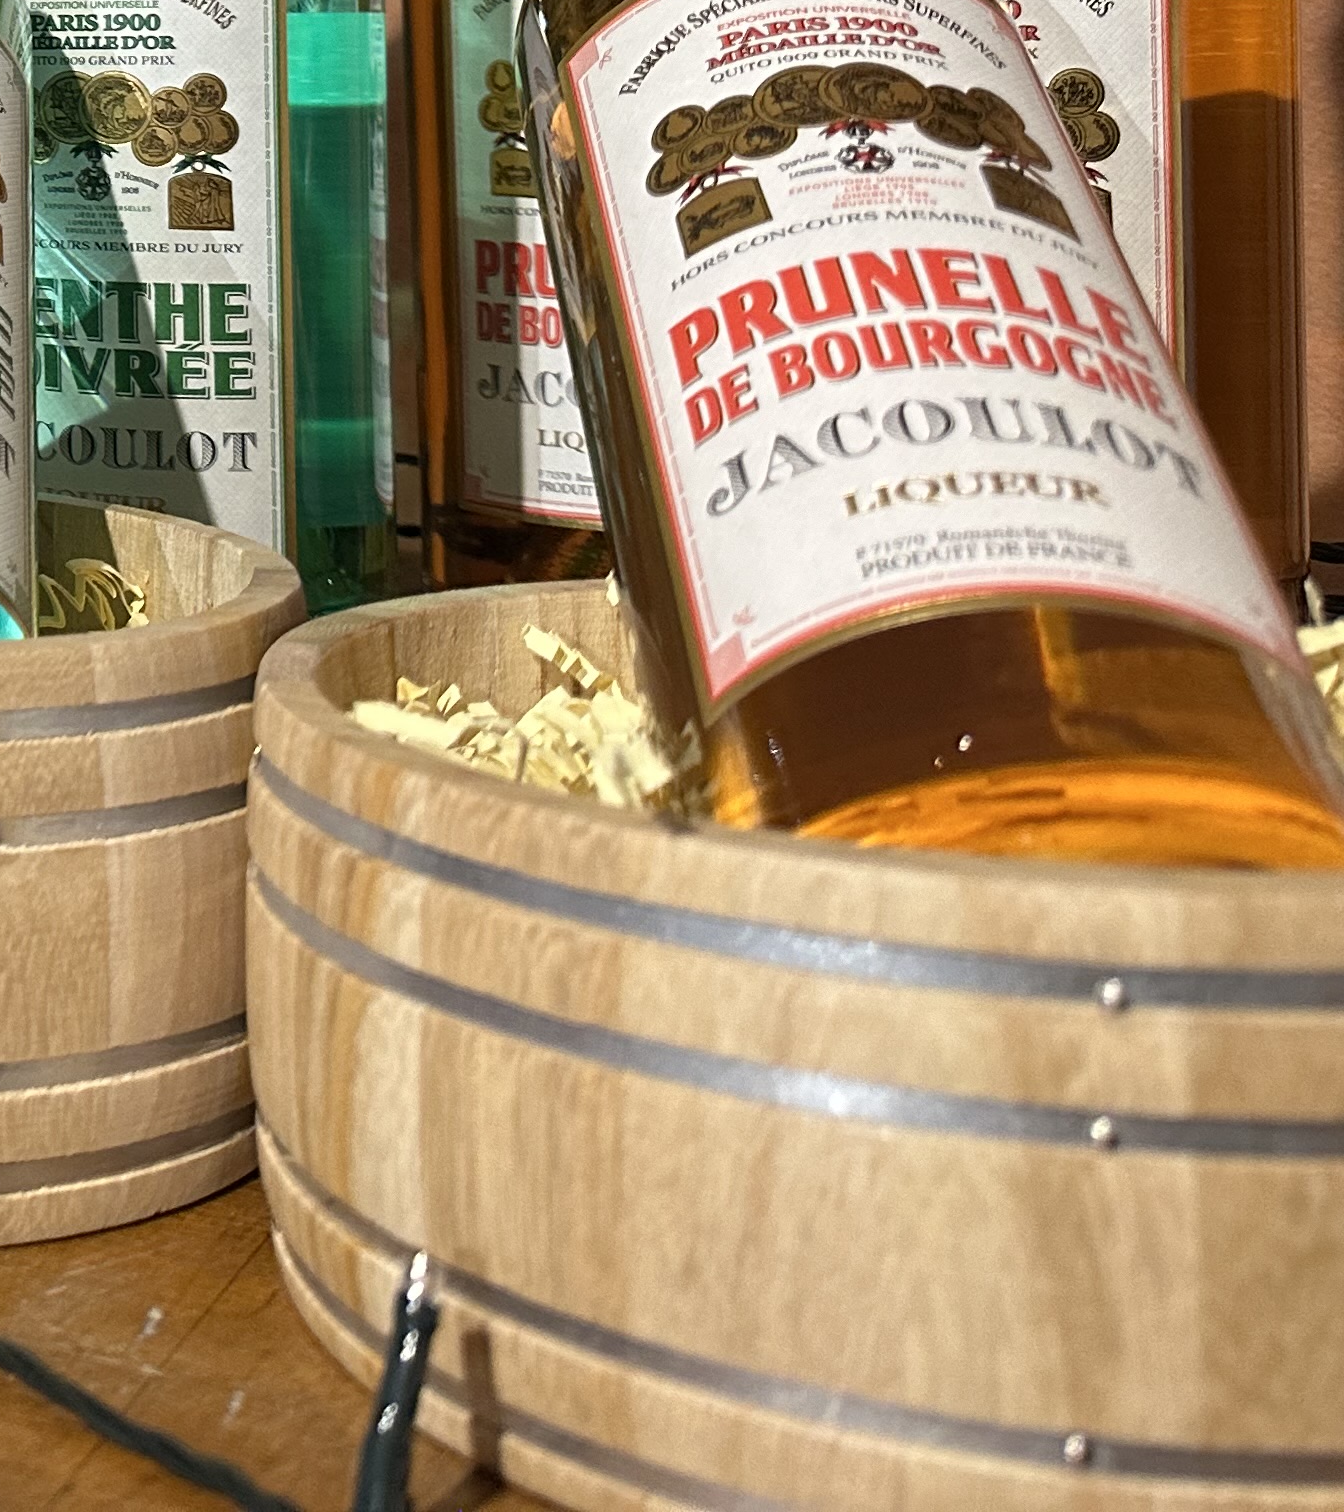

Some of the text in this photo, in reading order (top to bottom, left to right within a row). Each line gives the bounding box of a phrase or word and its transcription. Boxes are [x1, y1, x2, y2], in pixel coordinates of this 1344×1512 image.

[29, 0, 160, 10] EXPOSITION UNIVERSELLE
[31, 13, 162, 32] PARIS 1900
[716, 5, 911, 32] EXPOSITION UNIVERSELLE
[120, 35, 177, 50] D'OR
[704, 33, 947, 73] MÉDAILLE D'OR
[716, 15, 920, 51] PARIS 1900
[62, 54, 177, 66] 1909 GRAND PRIX
[618, 23, 692, 97] FABRIQUE
[709, 48, 951, 84] QUITO 1909 GRAND PRIX
[94, 242, 245, 254] MEMBRE DU JURY
[669, 208, 1045, 292] HORS CONCOURS MEMBRE DU
[35, 276, 252, 346] ENTHE
[667, 247, 1152, 391] PRUNELLE
[34, 342, 257, 401] IVRÉE
[684, 363, 759, 448] DE
[767, 318, 1181, 430] BOURGOGNE
[36, 419, 259, 473] COULOT
[705, 395, 1202, 518] JACOULOT
[842, 469, 1112, 518] LIQUEUR
[860, 541, 1135, 580] PRODUIT FRANCE
